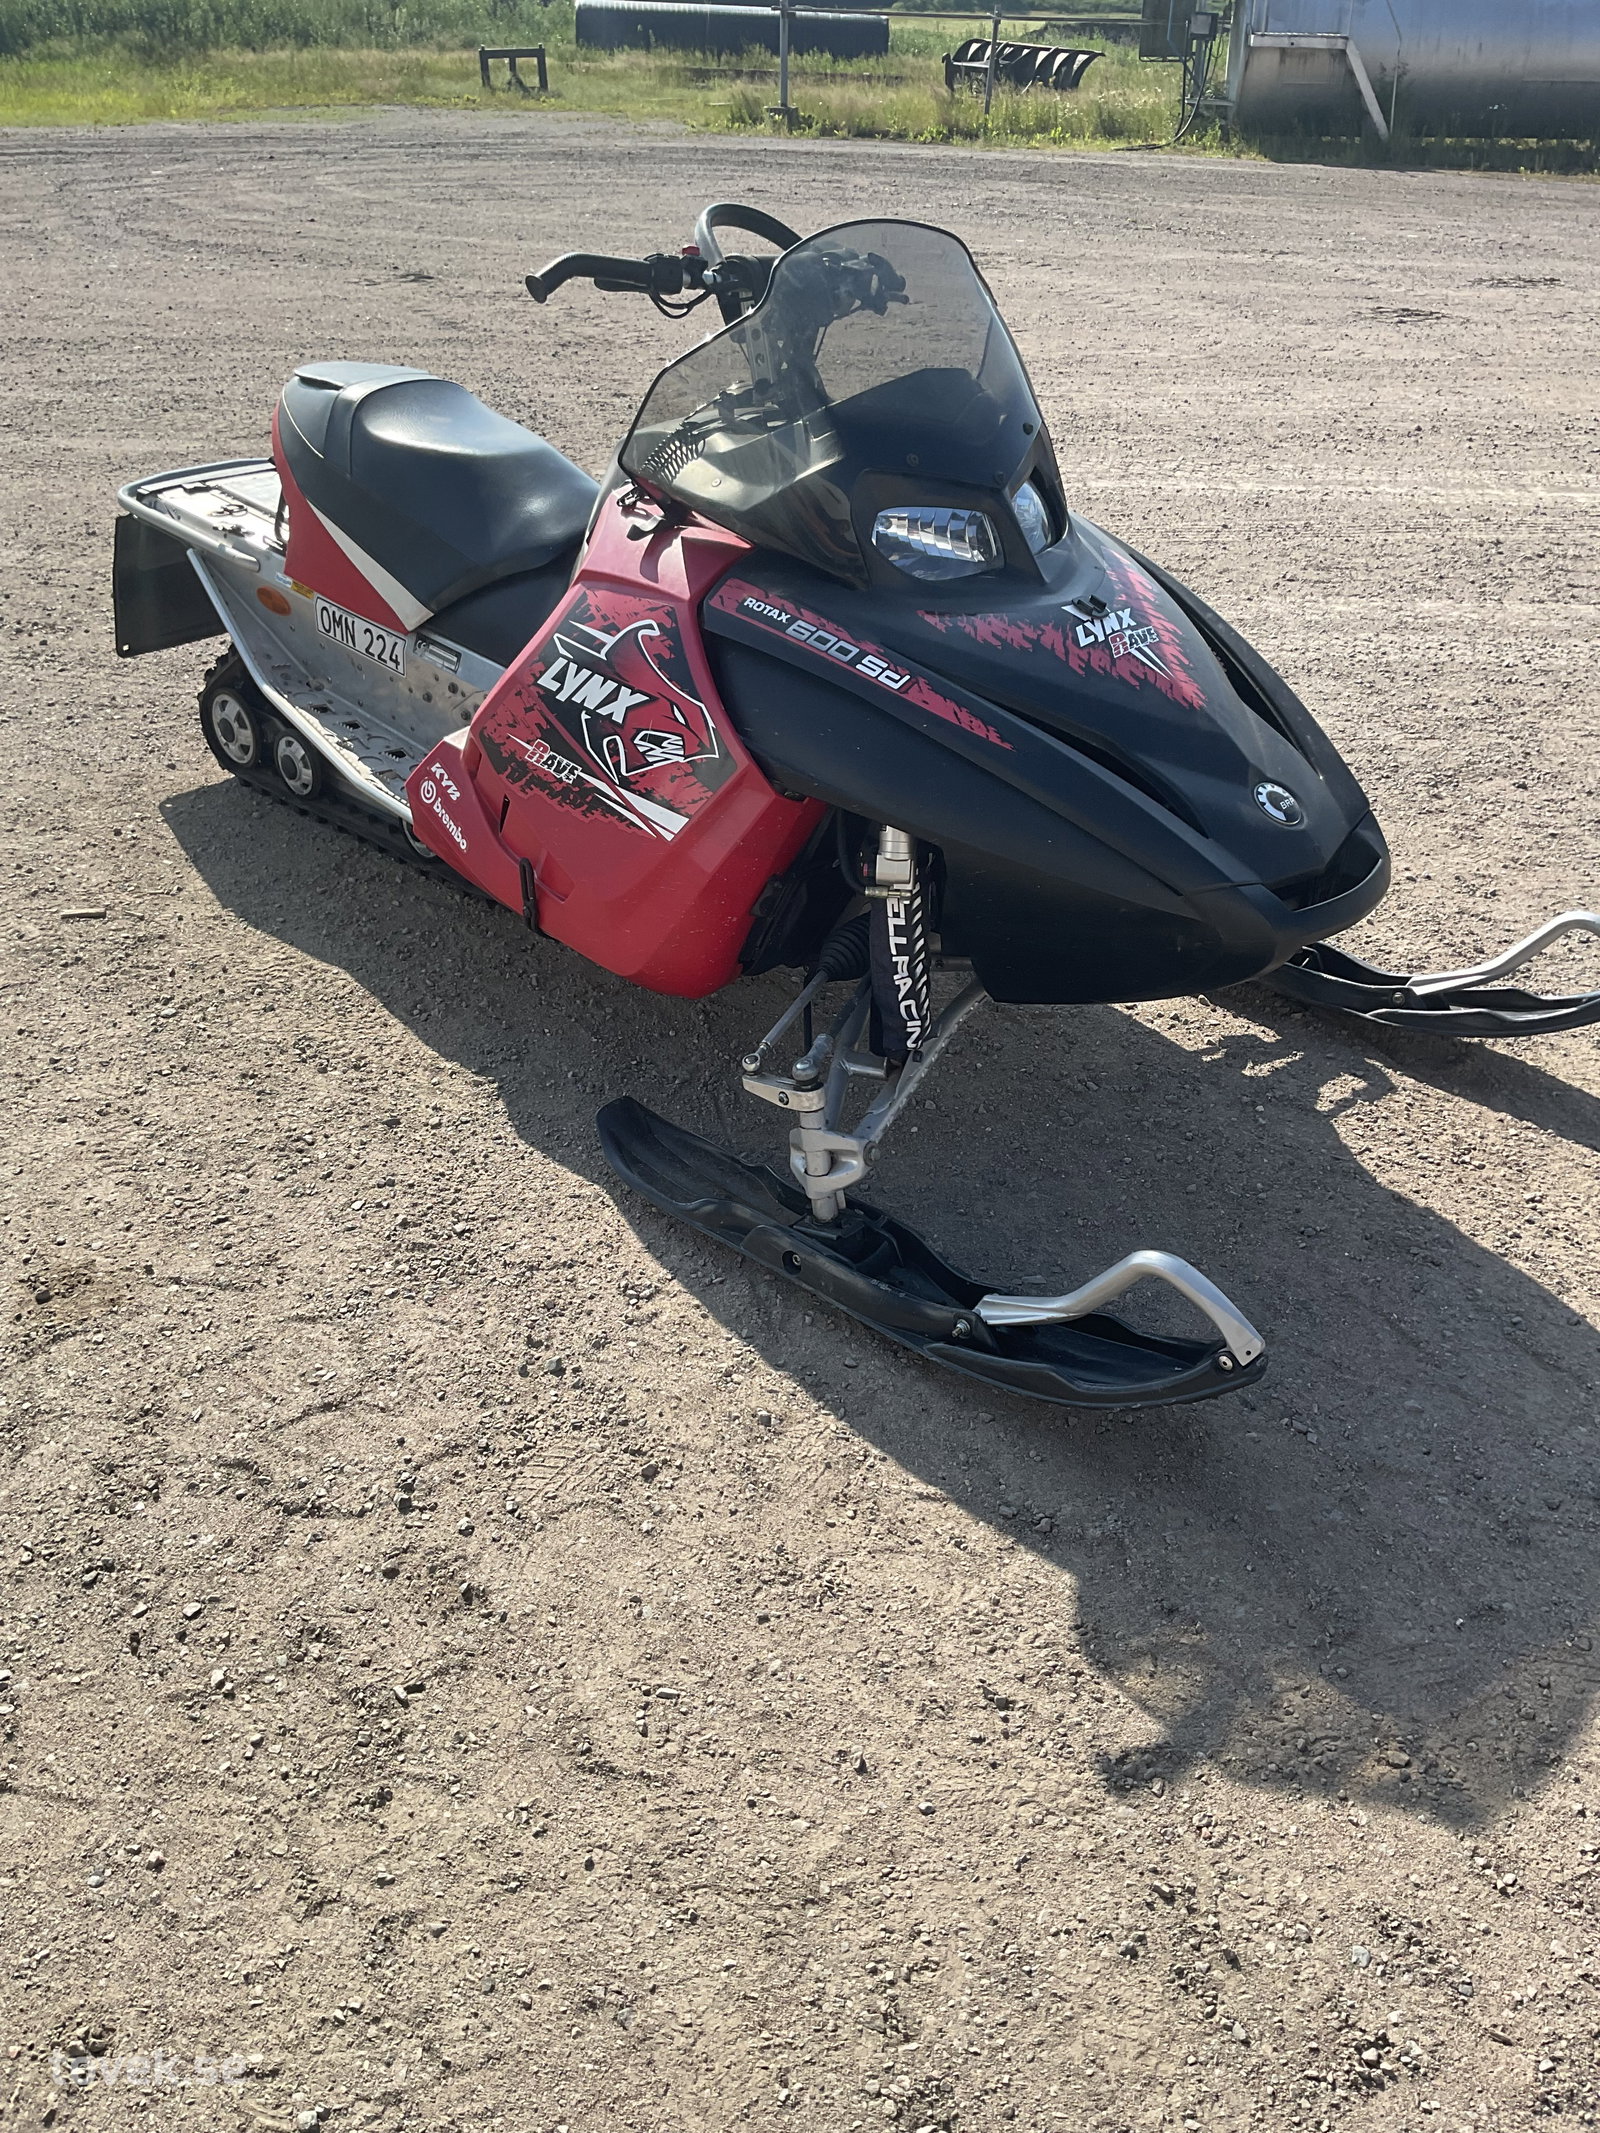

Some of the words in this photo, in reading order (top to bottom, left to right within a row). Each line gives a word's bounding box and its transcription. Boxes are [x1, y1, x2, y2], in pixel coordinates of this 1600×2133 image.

[320, 605, 356, 648] OMN
[363, 627, 400, 670] 224
[744, 597, 791, 624] ROTAX
[785, 619, 860, 663] 600
[1075, 607, 1137, 648] LYNX
[1108, 625, 1160, 658] RAVE
[537, 657, 650, 724] LYNX
[430, 762, 461, 801] KYB
[432, 797, 468, 850] brembo
